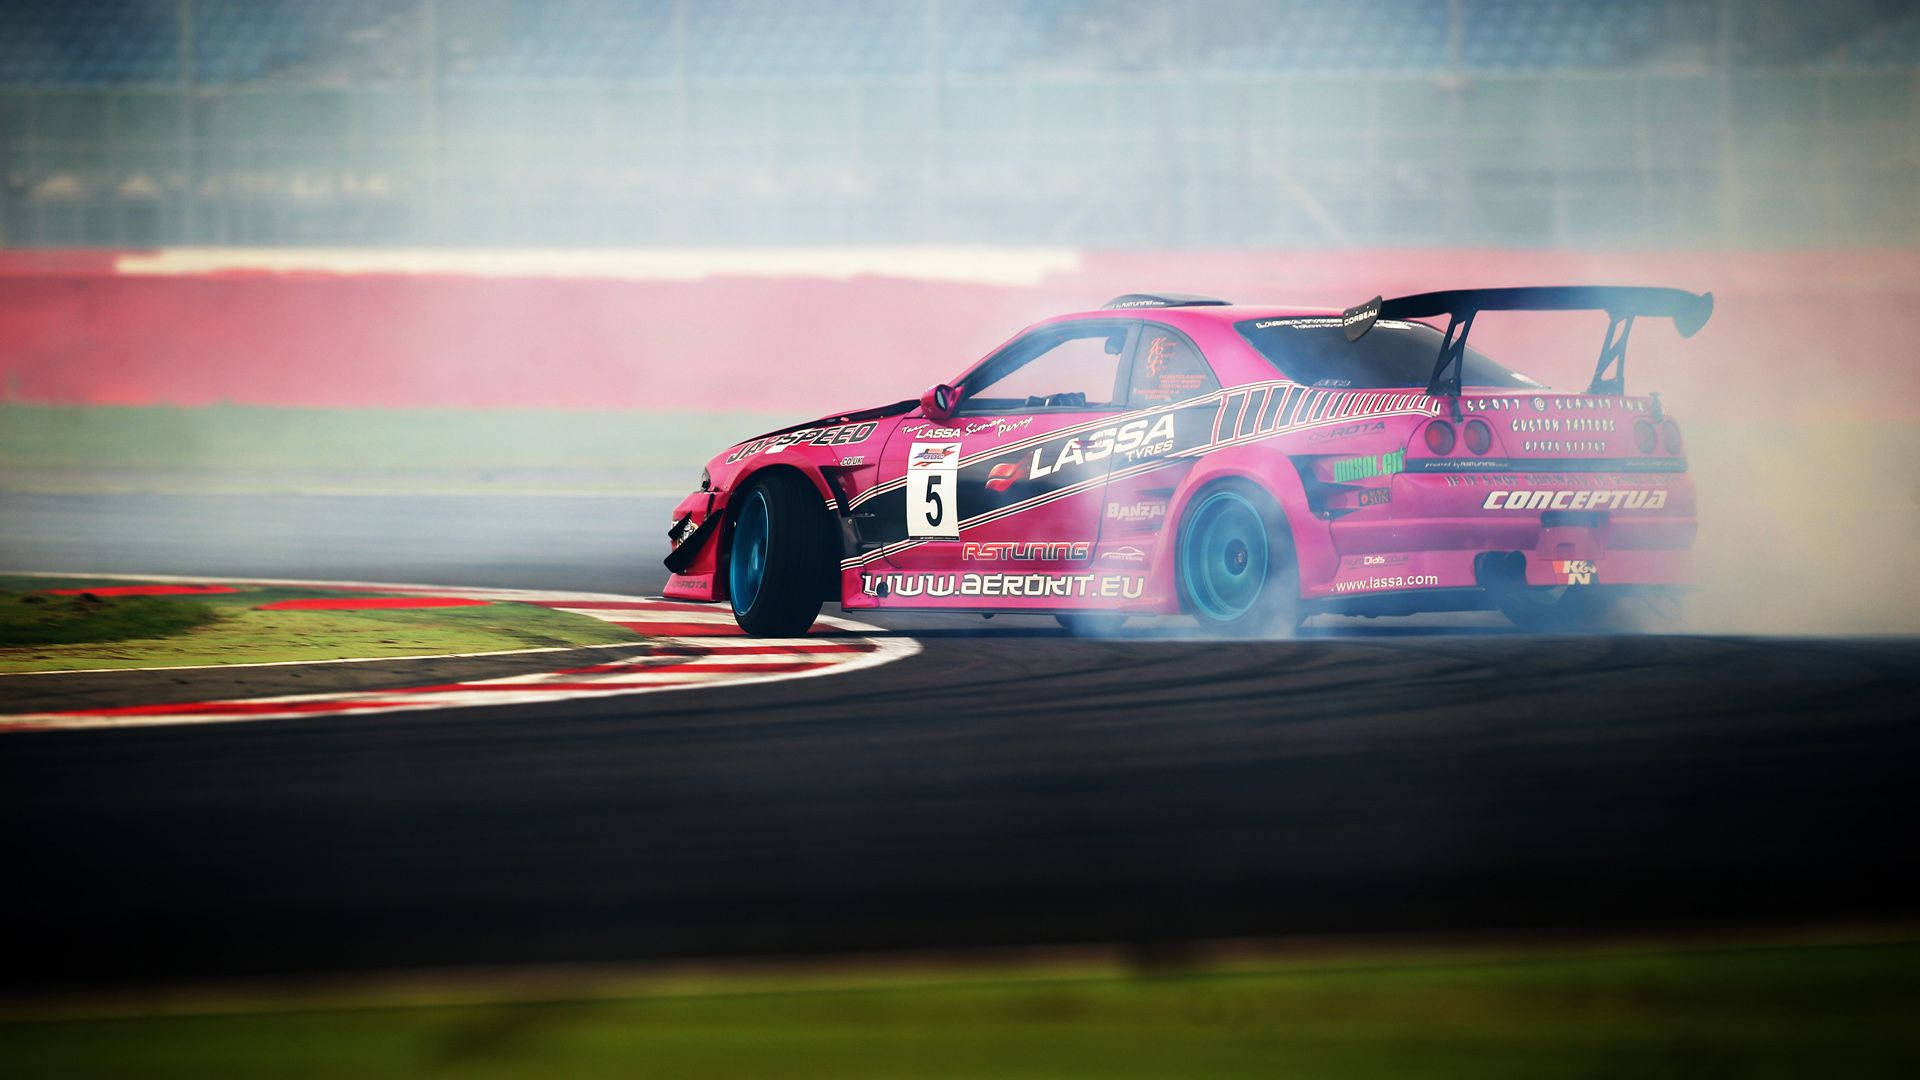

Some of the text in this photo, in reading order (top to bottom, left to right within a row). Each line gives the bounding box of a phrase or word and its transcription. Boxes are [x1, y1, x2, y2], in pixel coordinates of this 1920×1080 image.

[1344, 308, 1377, 327] CORBEAU
[1467, 399, 1519, 411] SCOTT
[1534, 397, 1544, 411] @
[915, 429, 960, 439] LASSA
[965, 418, 1005, 436] Simon
[726, 421, 879, 464] JAPSPEED
[1029, 413, 1175, 480] LASSA TYRES
[926, 476, 943, 527] 5
[1484, 490, 1667, 510] CONCEPTUA
[1107, 502, 1165, 519] BANZAI
[963, 542, 1090, 561] RSTUNING
[1336, 575, 1438, 592] www.lassa.com
